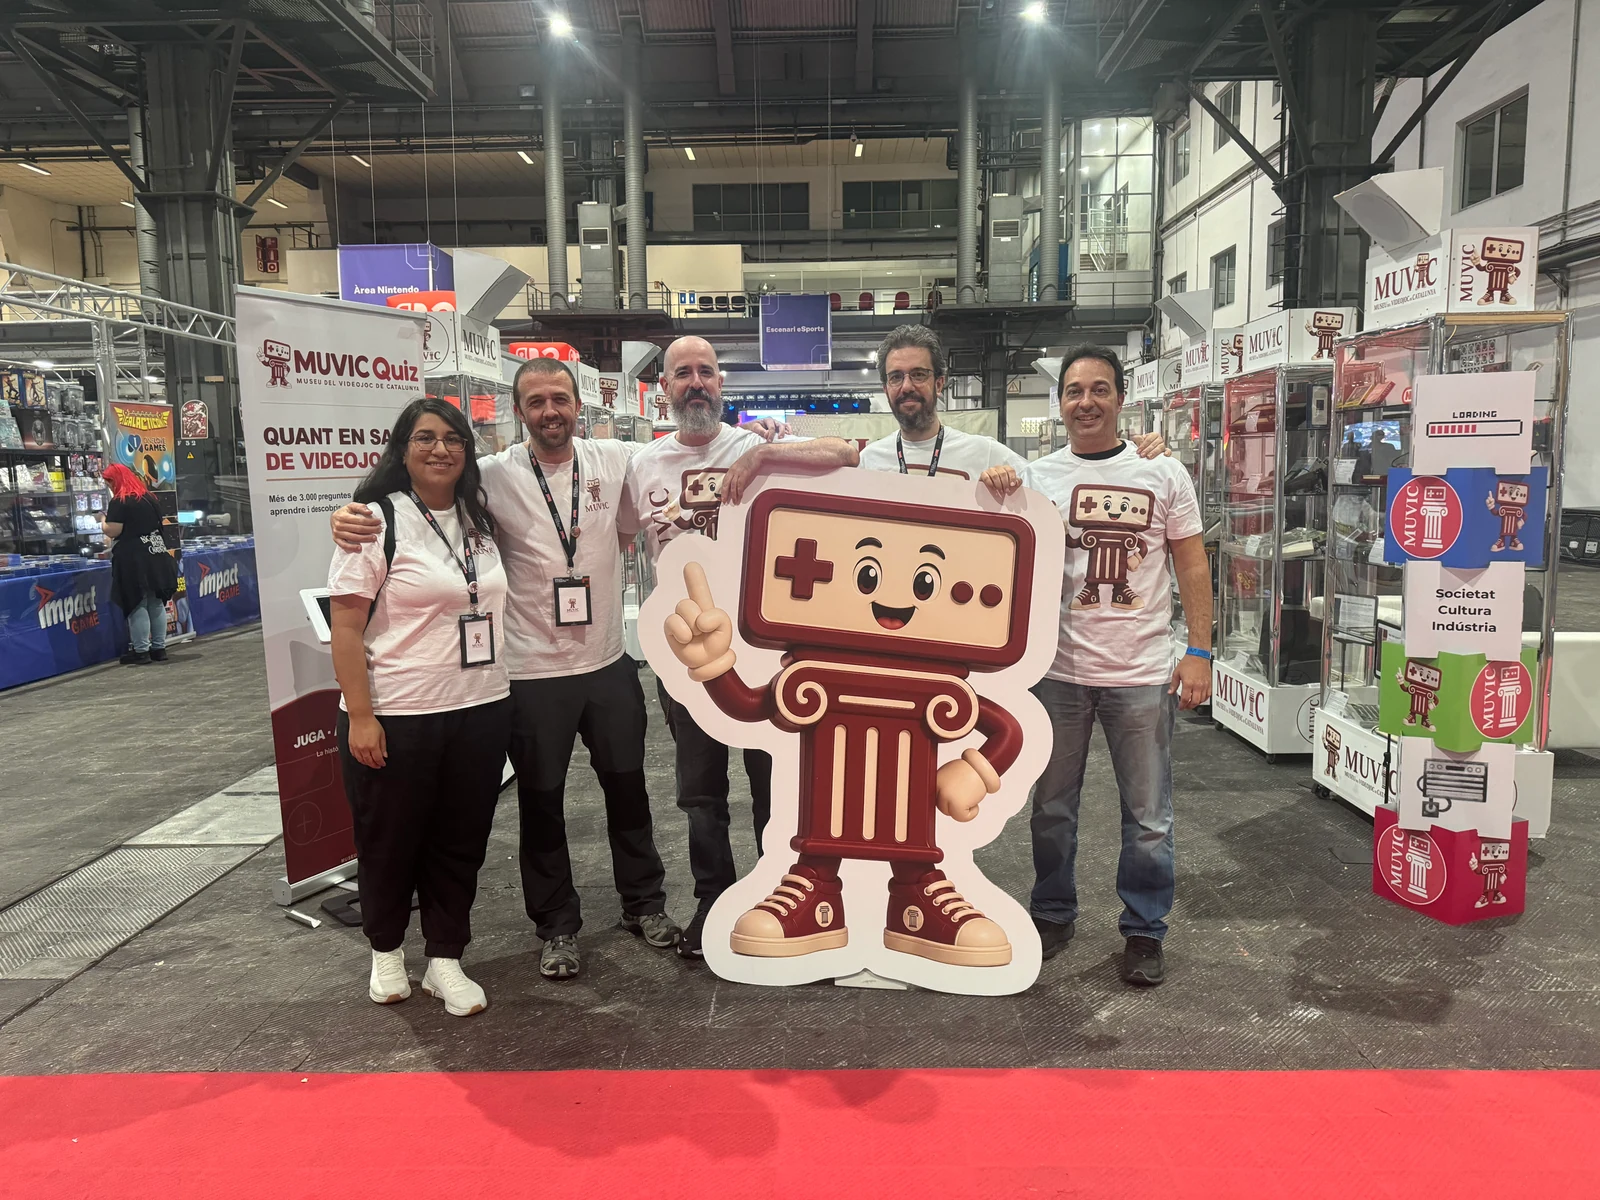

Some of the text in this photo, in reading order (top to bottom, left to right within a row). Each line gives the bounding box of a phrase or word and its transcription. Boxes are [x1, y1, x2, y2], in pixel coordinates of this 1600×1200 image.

[1374, 257, 1437, 301] MUVIC
[1460, 244, 1475, 302] MUVIC
[378, 285, 419, 294] Nintendo
[797, 326, 825, 334] eSports
[1249, 325, 1283, 354] MUVIC
[463, 329, 497, 361] MUVIC
[423, 351, 441, 360] VIC
[1221, 339, 1230, 375] MUVIC
[294, 350, 419, 382] MUVIC Quiz
[296, 378, 322, 386] MUSEU
[324, 379, 336, 387] DEL
[339, 380, 374, 389] VIDEOJOC
[386, 383, 420, 392] CATALUNYA
[1452, 411, 1498, 419] LOADING
[263, 427, 391, 447] QUANT EN SA
[144, 444, 167, 452] GAMES
[265, 451, 381, 470] DE VIDEOJO
[268, 492, 352, 503] Més de 3.000 preguntes
[585, 502, 610, 513] MUVIC
[270, 506, 306, 516] aprendre
[1404, 485, 1419, 547] MUVIC
[199, 563, 239, 599] impact
[219, 585, 240, 603] GAME
[1435, 588, 1496, 600] Societat
[39, 586, 97, 630] impact
[1438, 605, 1492, 616] Cultura
[71, 611, 100, 635] GAME
[1432, 621, 1497, 633] Indústria
[1216, 669, 1265, 723] MUVIC
[1482, 668, 1496, 730] MUVIC
[293, 729, 326, 749] JUGA
[1390, 829, 1405, 889] MUVIC
